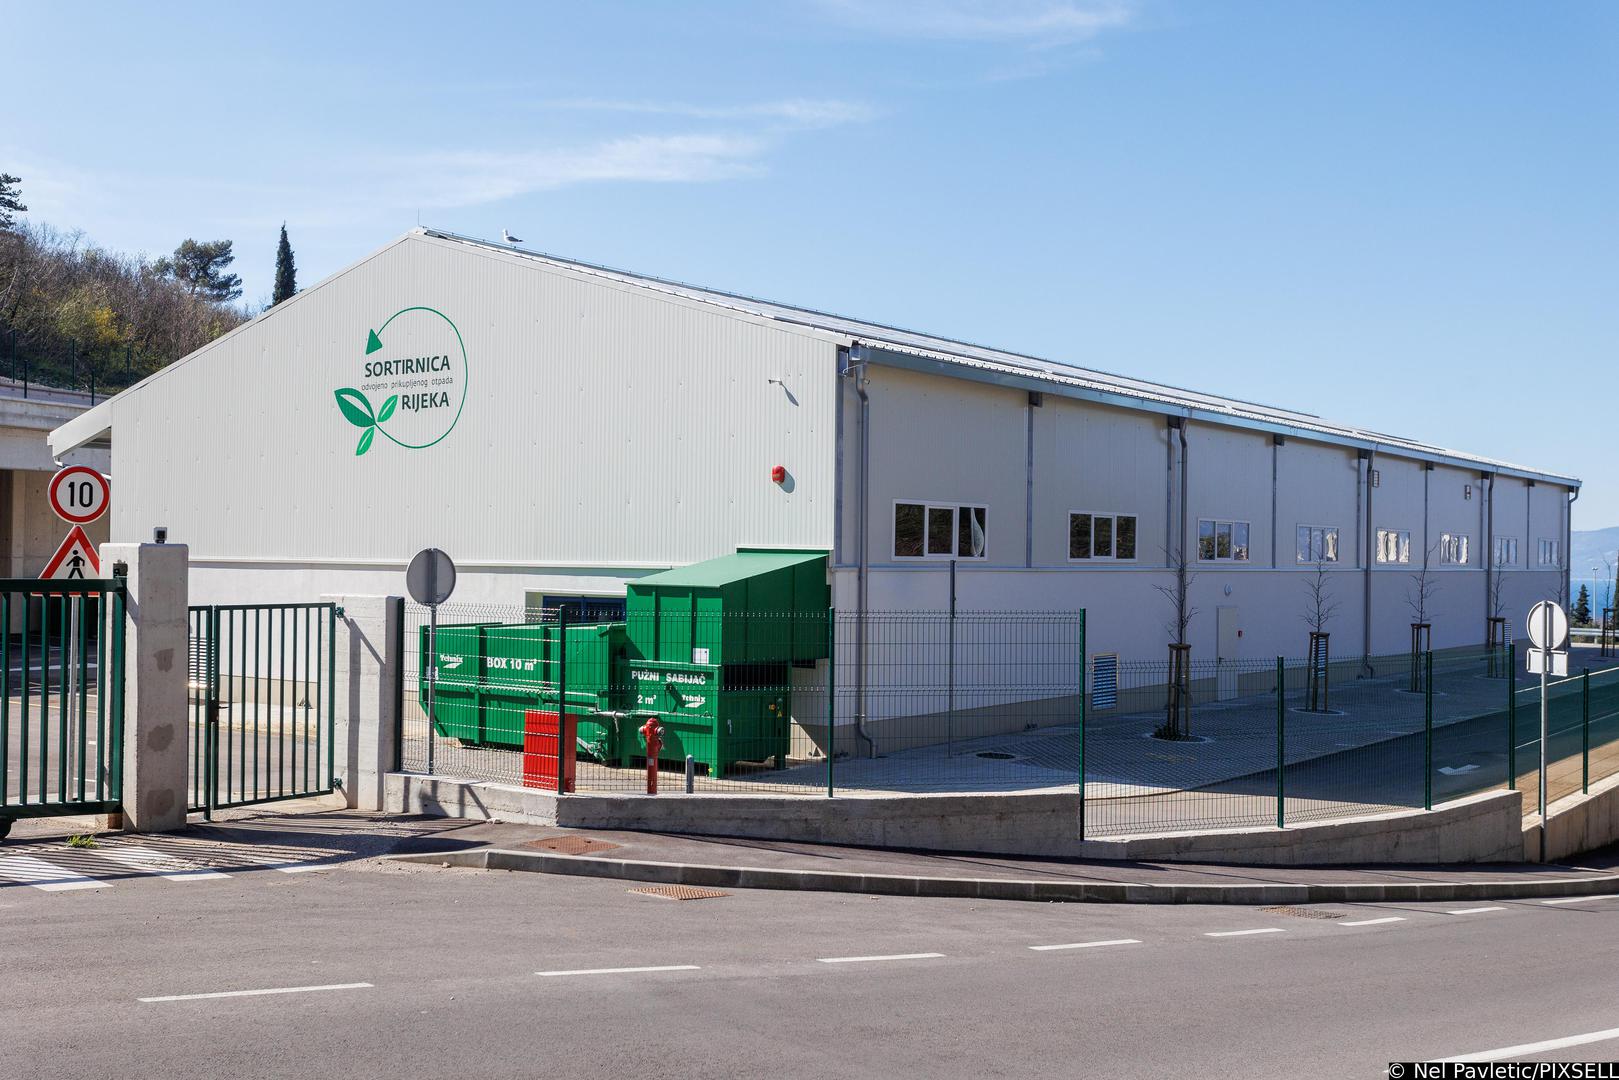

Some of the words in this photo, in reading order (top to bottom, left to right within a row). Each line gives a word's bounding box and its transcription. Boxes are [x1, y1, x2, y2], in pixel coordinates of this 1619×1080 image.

[365, 355, 450, 378] SORTIRNICA
[361, 382, 388, 392] odvojeno
[391, 379, 428, 389] prikupljenog
[431, 376, 453, 386] otpada
[402, 391, 449, 412] RIJEKA
[68, 481, 93, 508] 10
[486, 656, 507, 669] BOX
[510, 658, 521, 670] 10
[631, 669, 659, 682] PUŽNI
[666, 673, 706, 685] SABIJAČ
[637, 694, 643, 704] 2
[645, 694, 657, 705] m³
